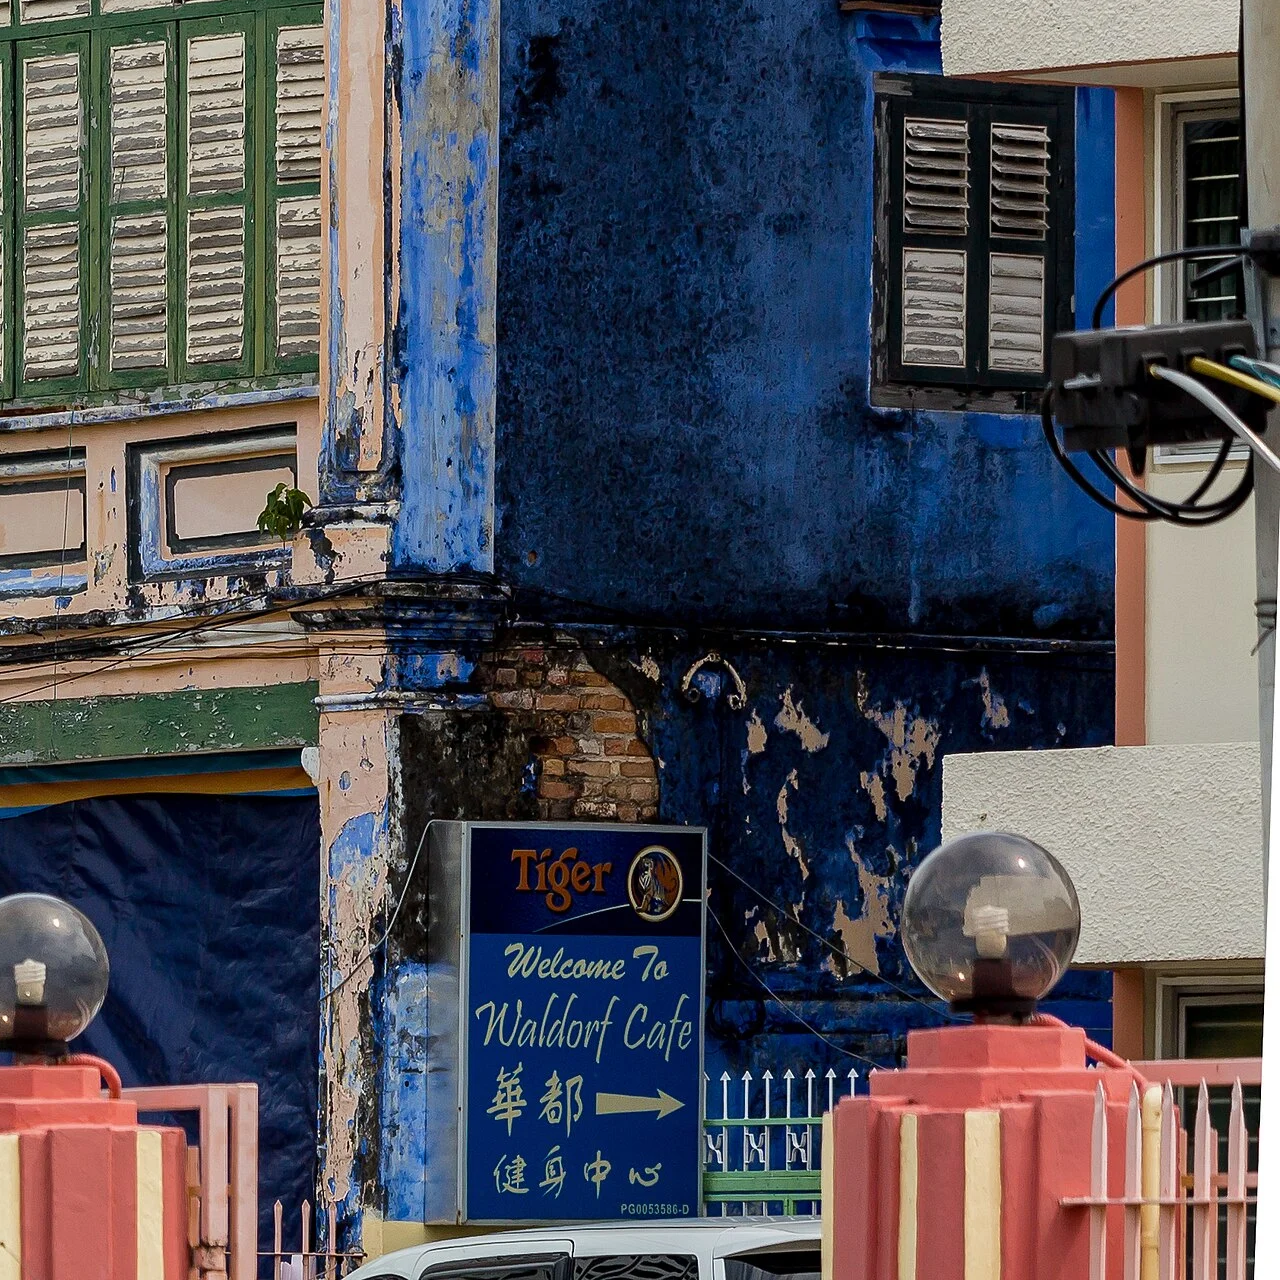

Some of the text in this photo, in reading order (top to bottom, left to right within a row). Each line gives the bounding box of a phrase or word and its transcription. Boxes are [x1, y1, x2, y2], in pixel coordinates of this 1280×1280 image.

[511, 847, 612, 912] Tiger
[504, 942, 669, 982] Welcome To
[475, 993, 692, 1063] Waldorf Cafe
[486, 1061, 583, 1138] 華都
[493, 1145, 662, 1199] 健身中心
[620, 1203, 690, 1215] PG0053586-D
